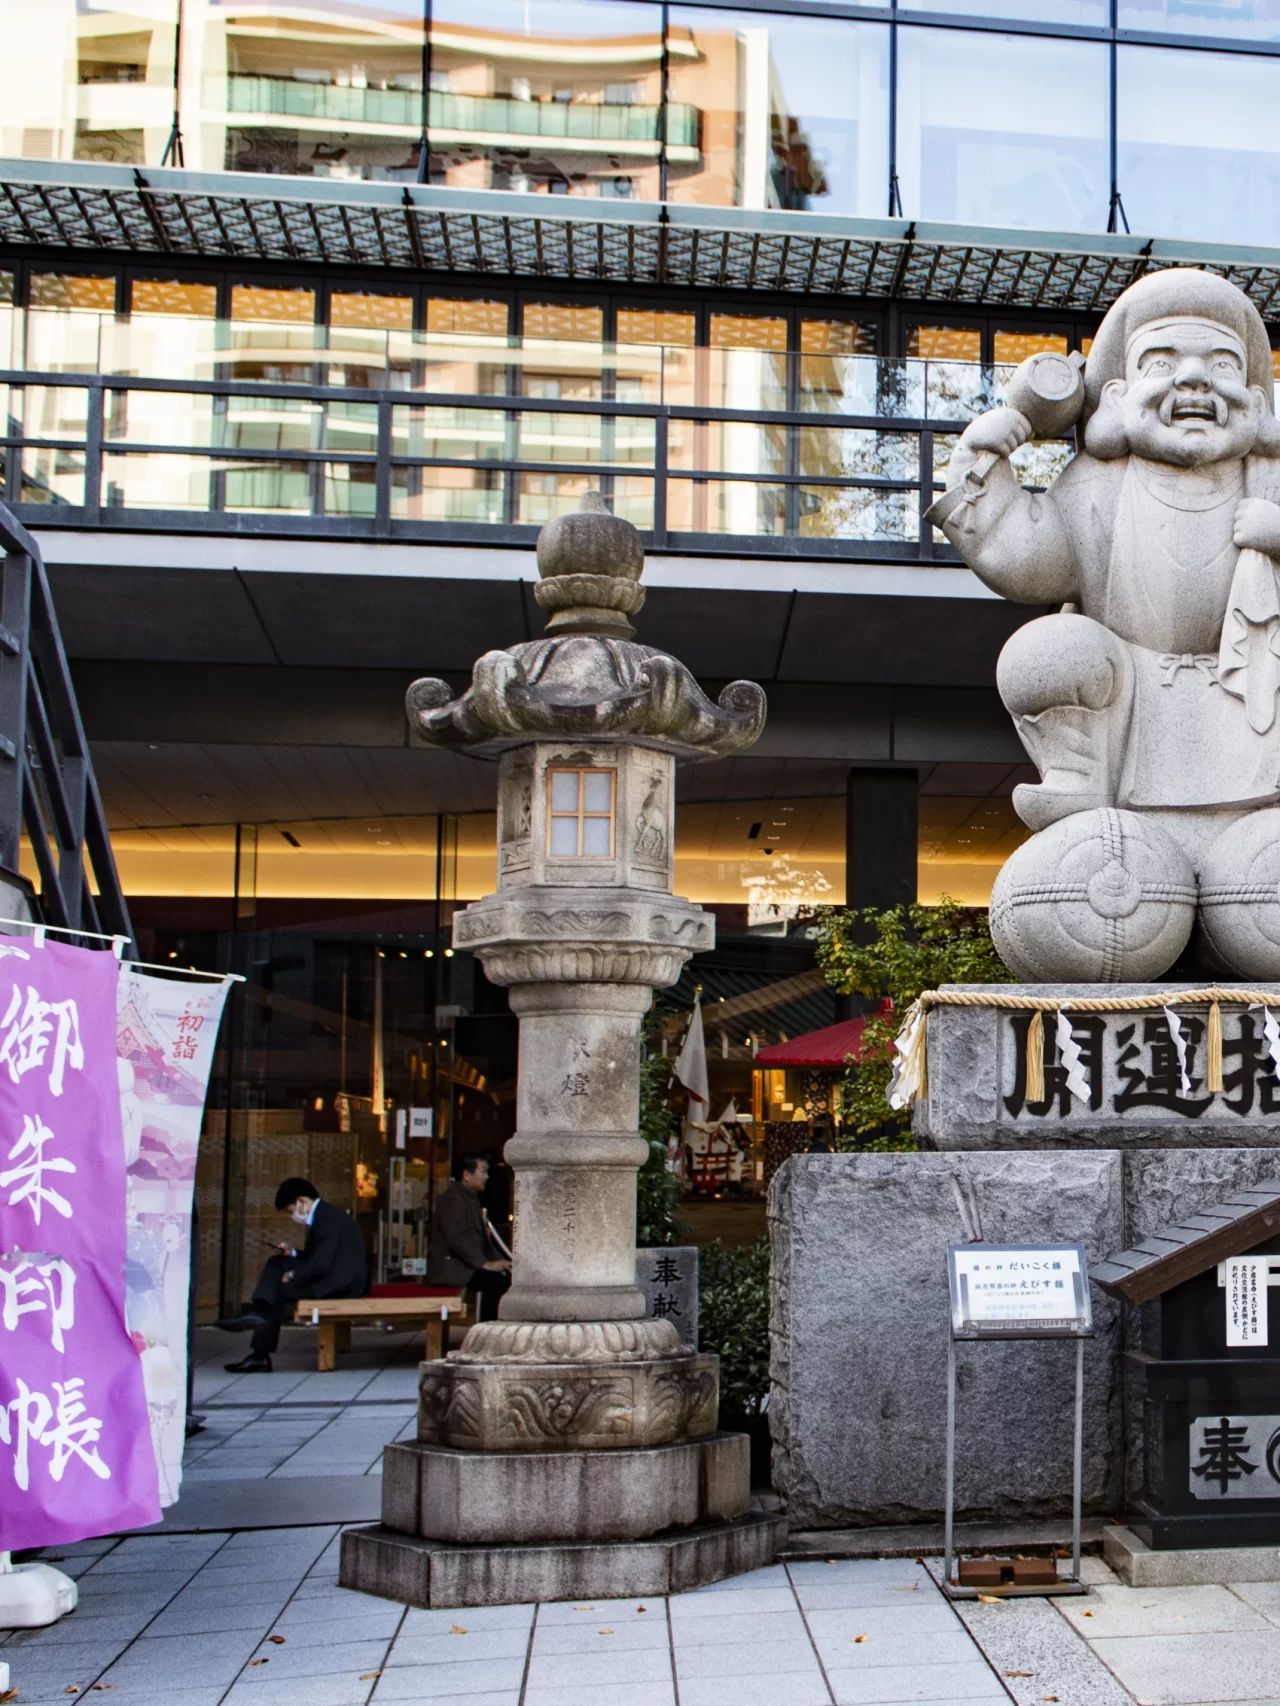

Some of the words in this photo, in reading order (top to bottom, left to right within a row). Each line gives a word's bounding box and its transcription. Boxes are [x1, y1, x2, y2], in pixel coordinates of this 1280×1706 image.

[172, 1010, 205, 1060] 初詣
[0, 984, 110, 1491] 御朱印帳
[650, 1256, 683, 1318] 奉献
[1009, 1261, 1062, 1271] だいこく様
[1019, 1279, 1065, 1290] えびす様
